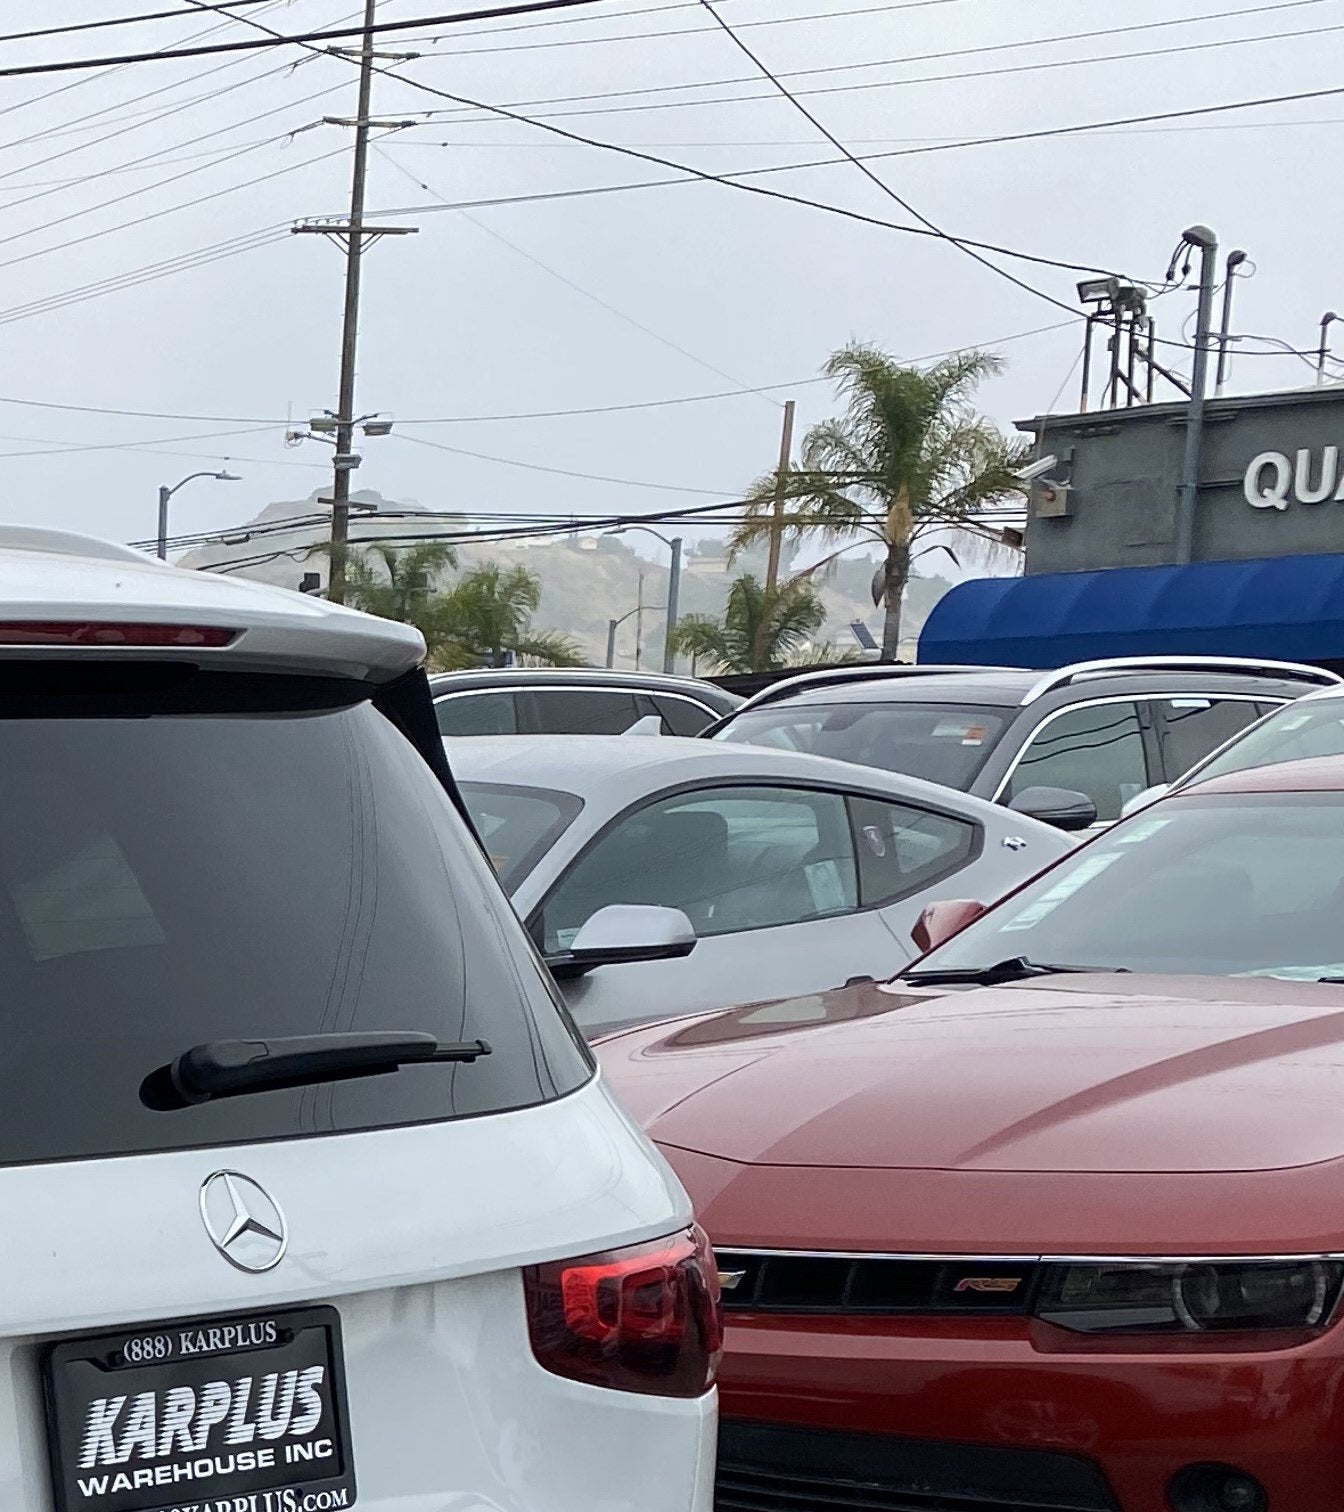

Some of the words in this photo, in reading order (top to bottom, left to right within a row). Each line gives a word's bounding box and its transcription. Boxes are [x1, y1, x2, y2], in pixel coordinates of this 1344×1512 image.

[1244, 445, 1344, 511] QU
[953, 1277, 1023, 1292] RS
[122, 1337, 173, 1363] (888)
[178, 1320, 277, 1355] KARPLUS
[76, 1365, 325, 1469] KARPLUS
[76, 1446, 275, 1498] WAREHOUSE
[284, 1437, 334, 1464] INC
